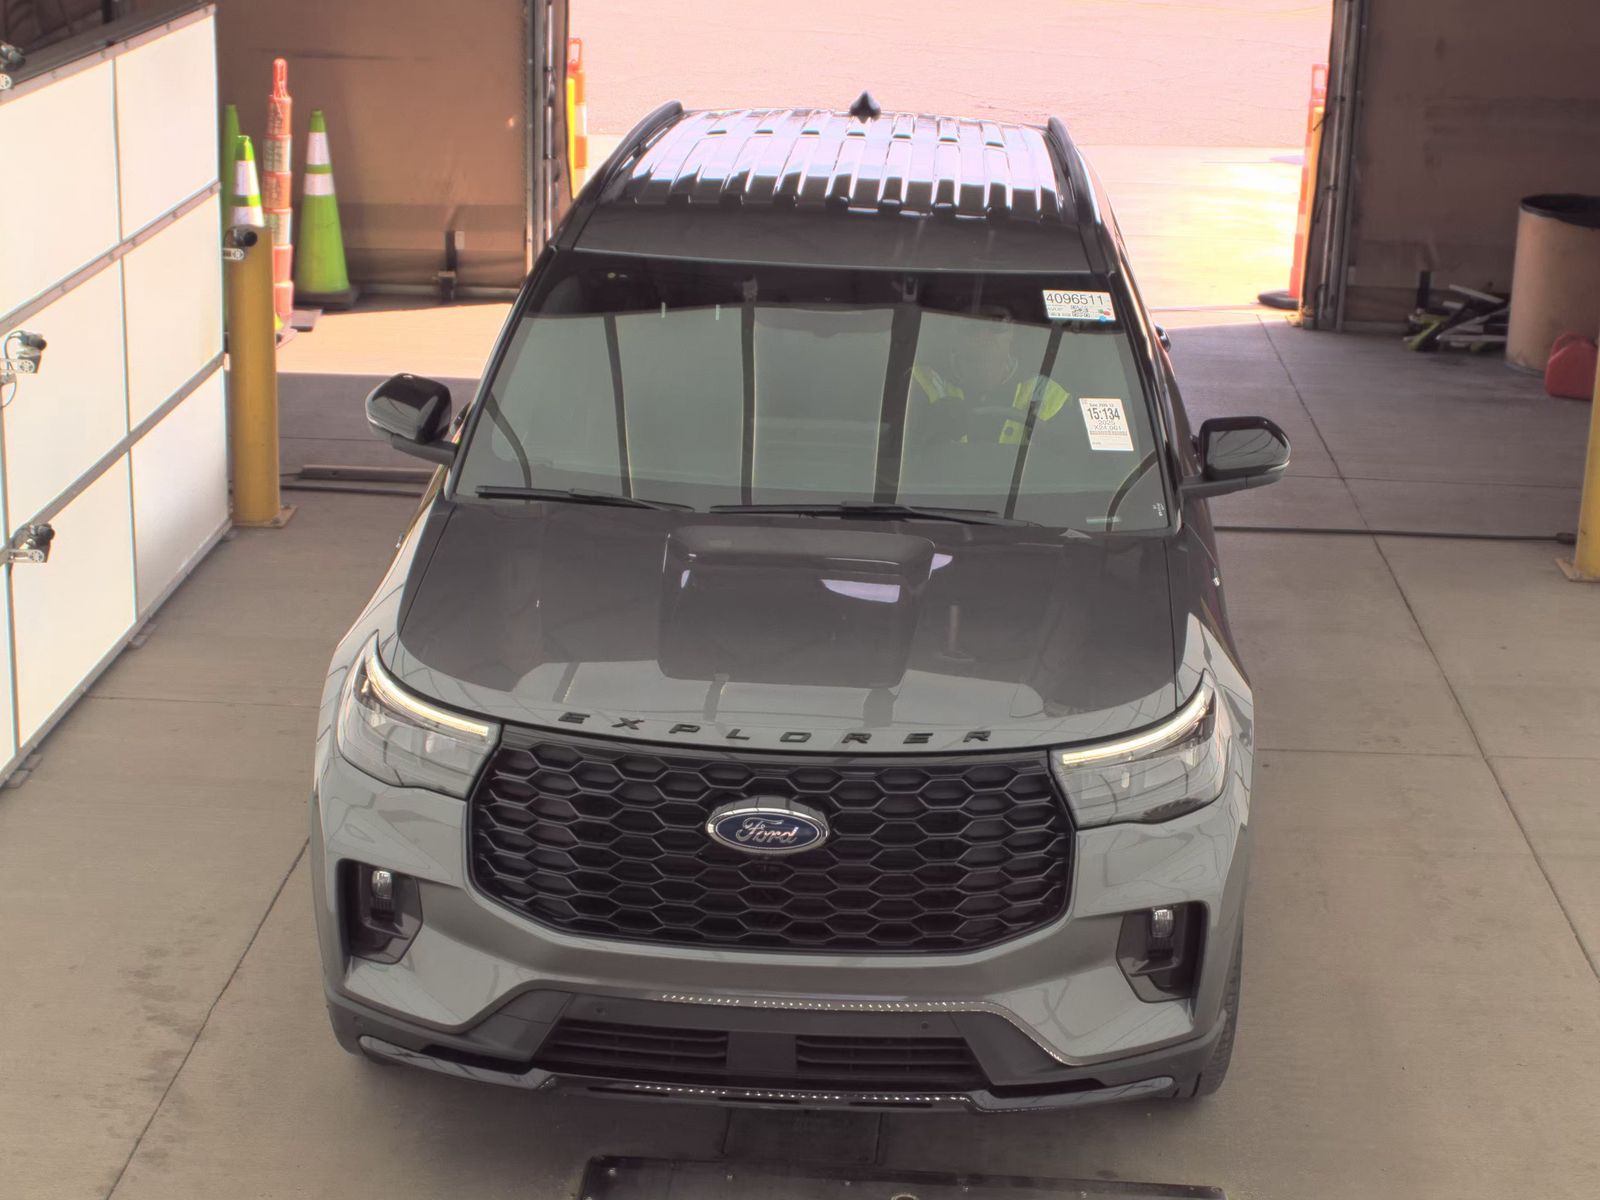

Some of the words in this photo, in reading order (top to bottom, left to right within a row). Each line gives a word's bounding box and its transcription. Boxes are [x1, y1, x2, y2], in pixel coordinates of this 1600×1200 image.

[1046, 293, 1104, 305] 4096511
[1087, 407, 1121, 420] 15:134
[558, 711, 991, 744] EXPLORER
[736, 817, 800, 843] Ford
